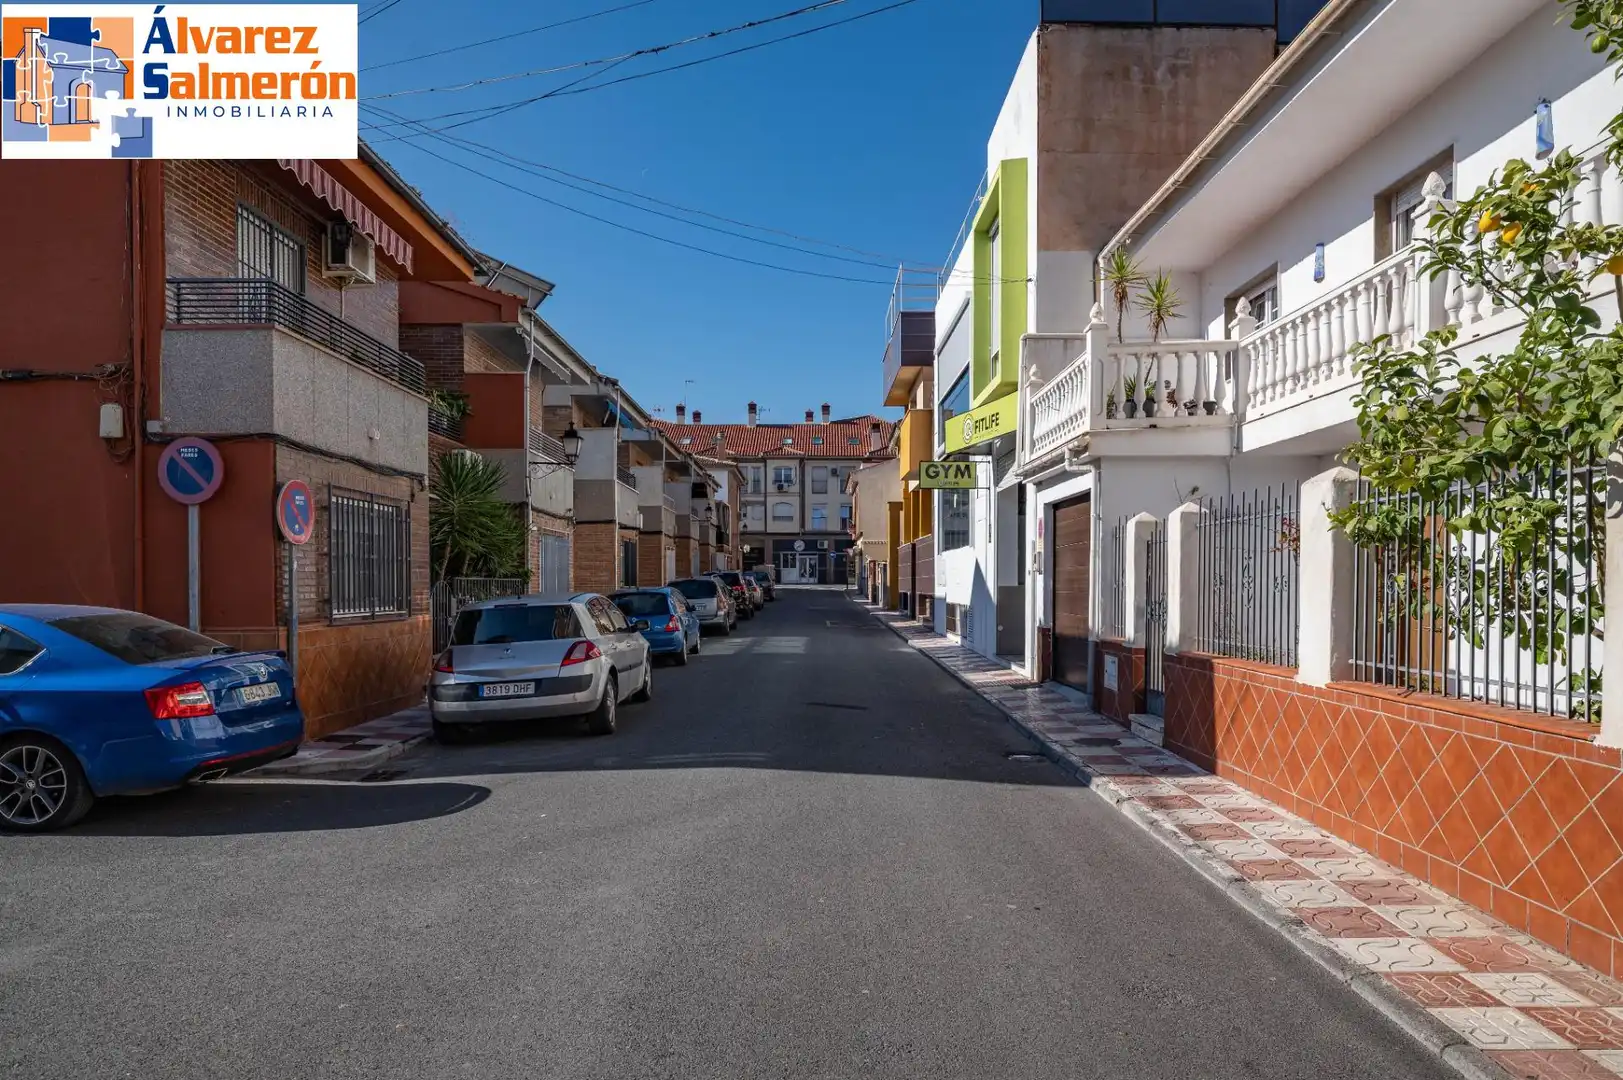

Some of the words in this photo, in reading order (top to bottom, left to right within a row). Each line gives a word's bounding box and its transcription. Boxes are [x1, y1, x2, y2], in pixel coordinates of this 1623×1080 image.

[974, 412, 1000, 434] FITLIFE
[925, 463, 972, 480] GYM
[485, 685, 510, 695] 3819
[513, 684, 532, 693] DHF
